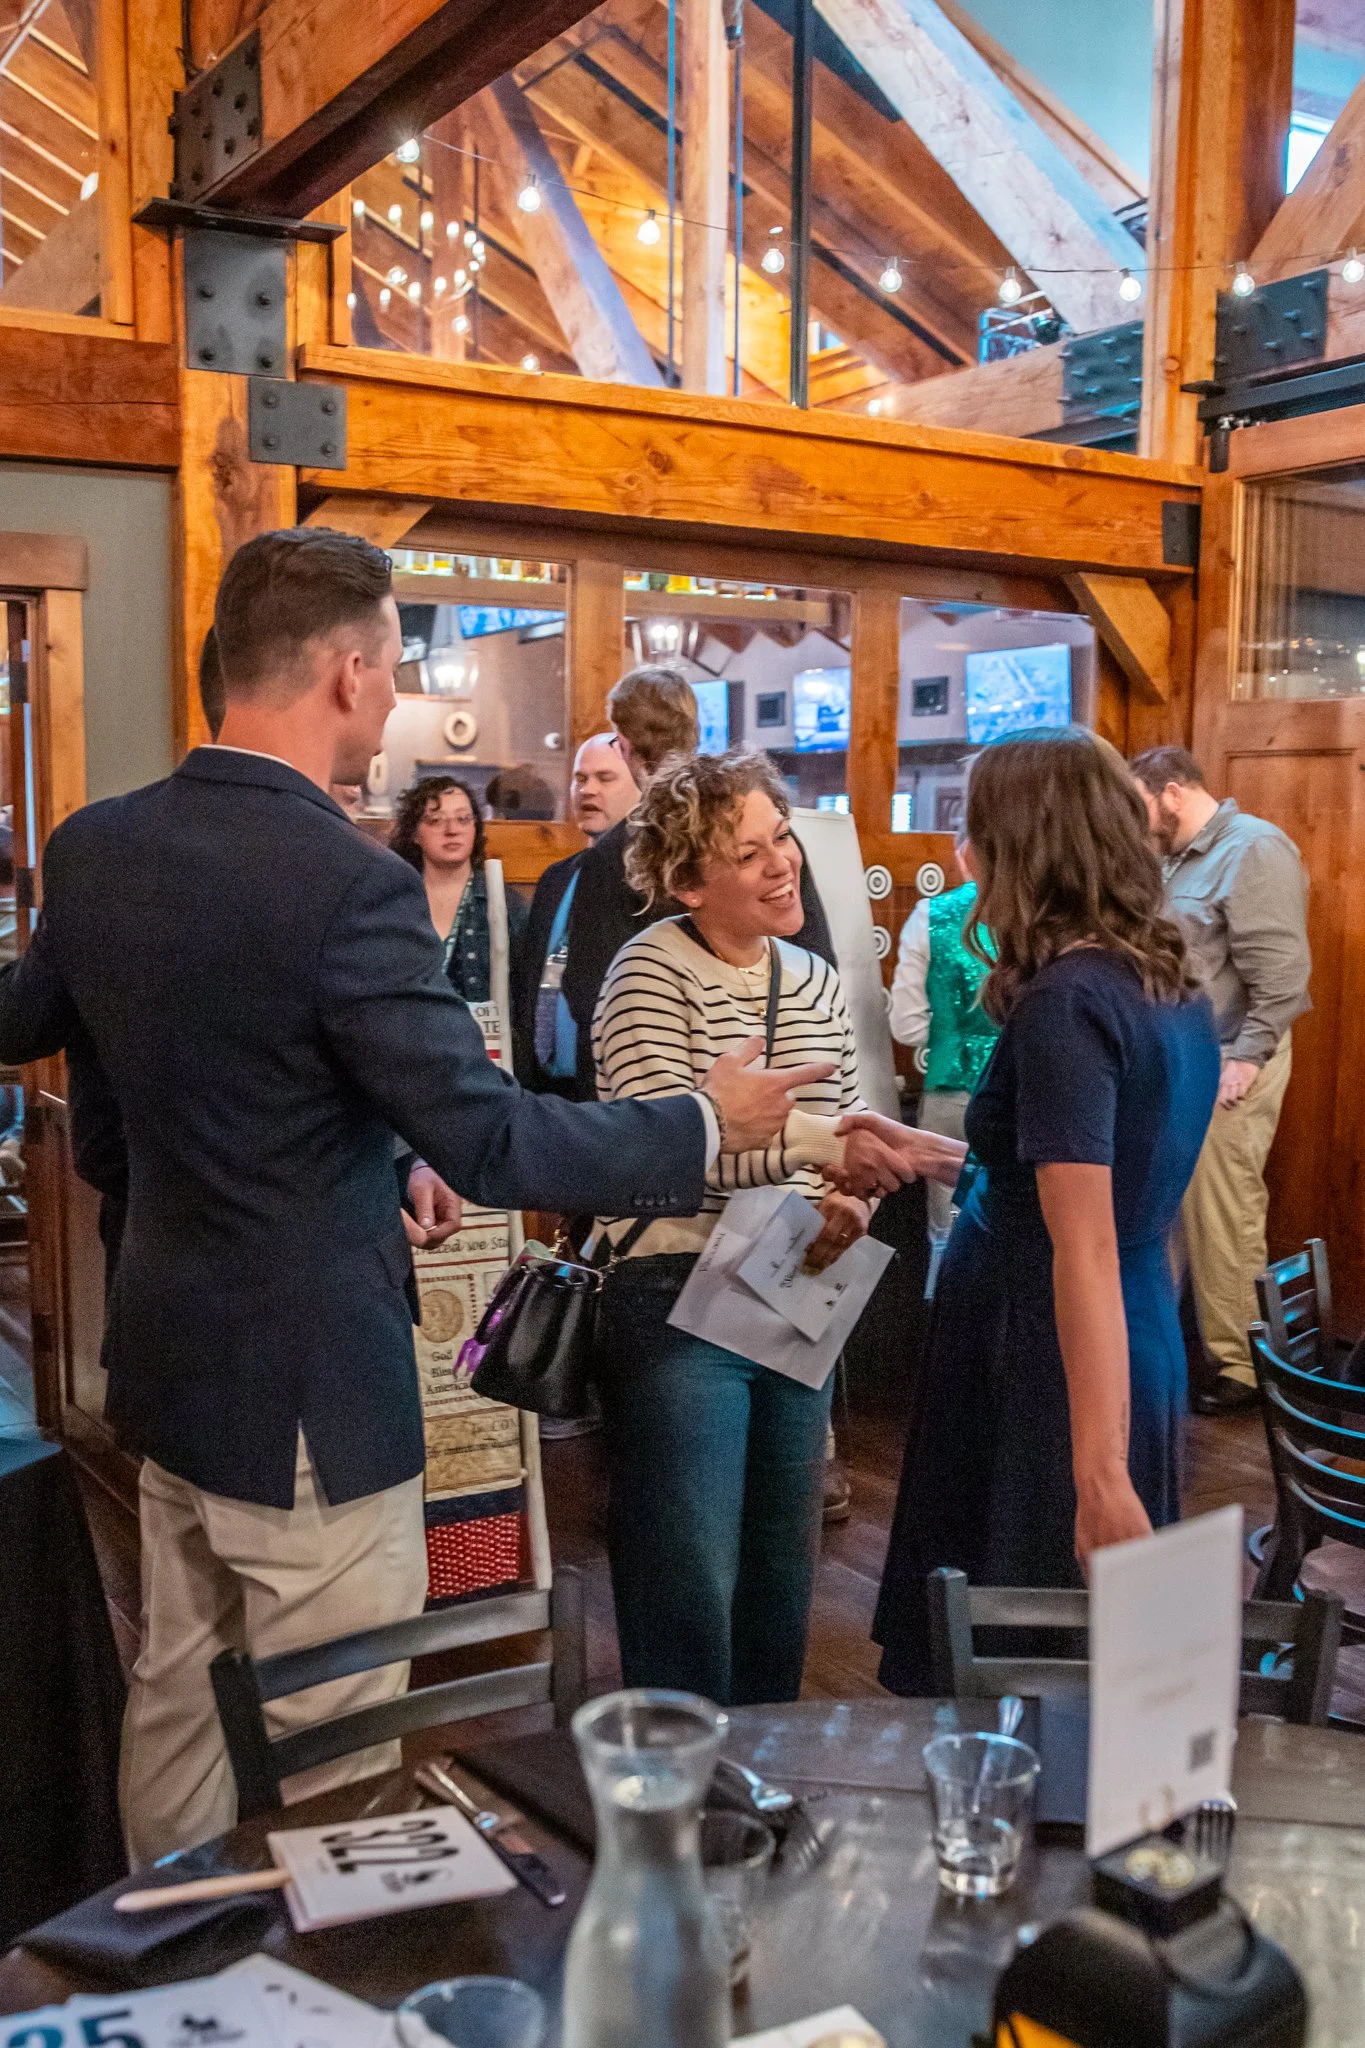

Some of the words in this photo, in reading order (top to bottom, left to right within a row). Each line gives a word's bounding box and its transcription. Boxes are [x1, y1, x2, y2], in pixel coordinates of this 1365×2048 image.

[466, 1240, 487, 1252] we
[431, 1350, 453, 1361] God
[431, 1366, 457, 1378] Bles
[425, 1382, 469, 1395] America
